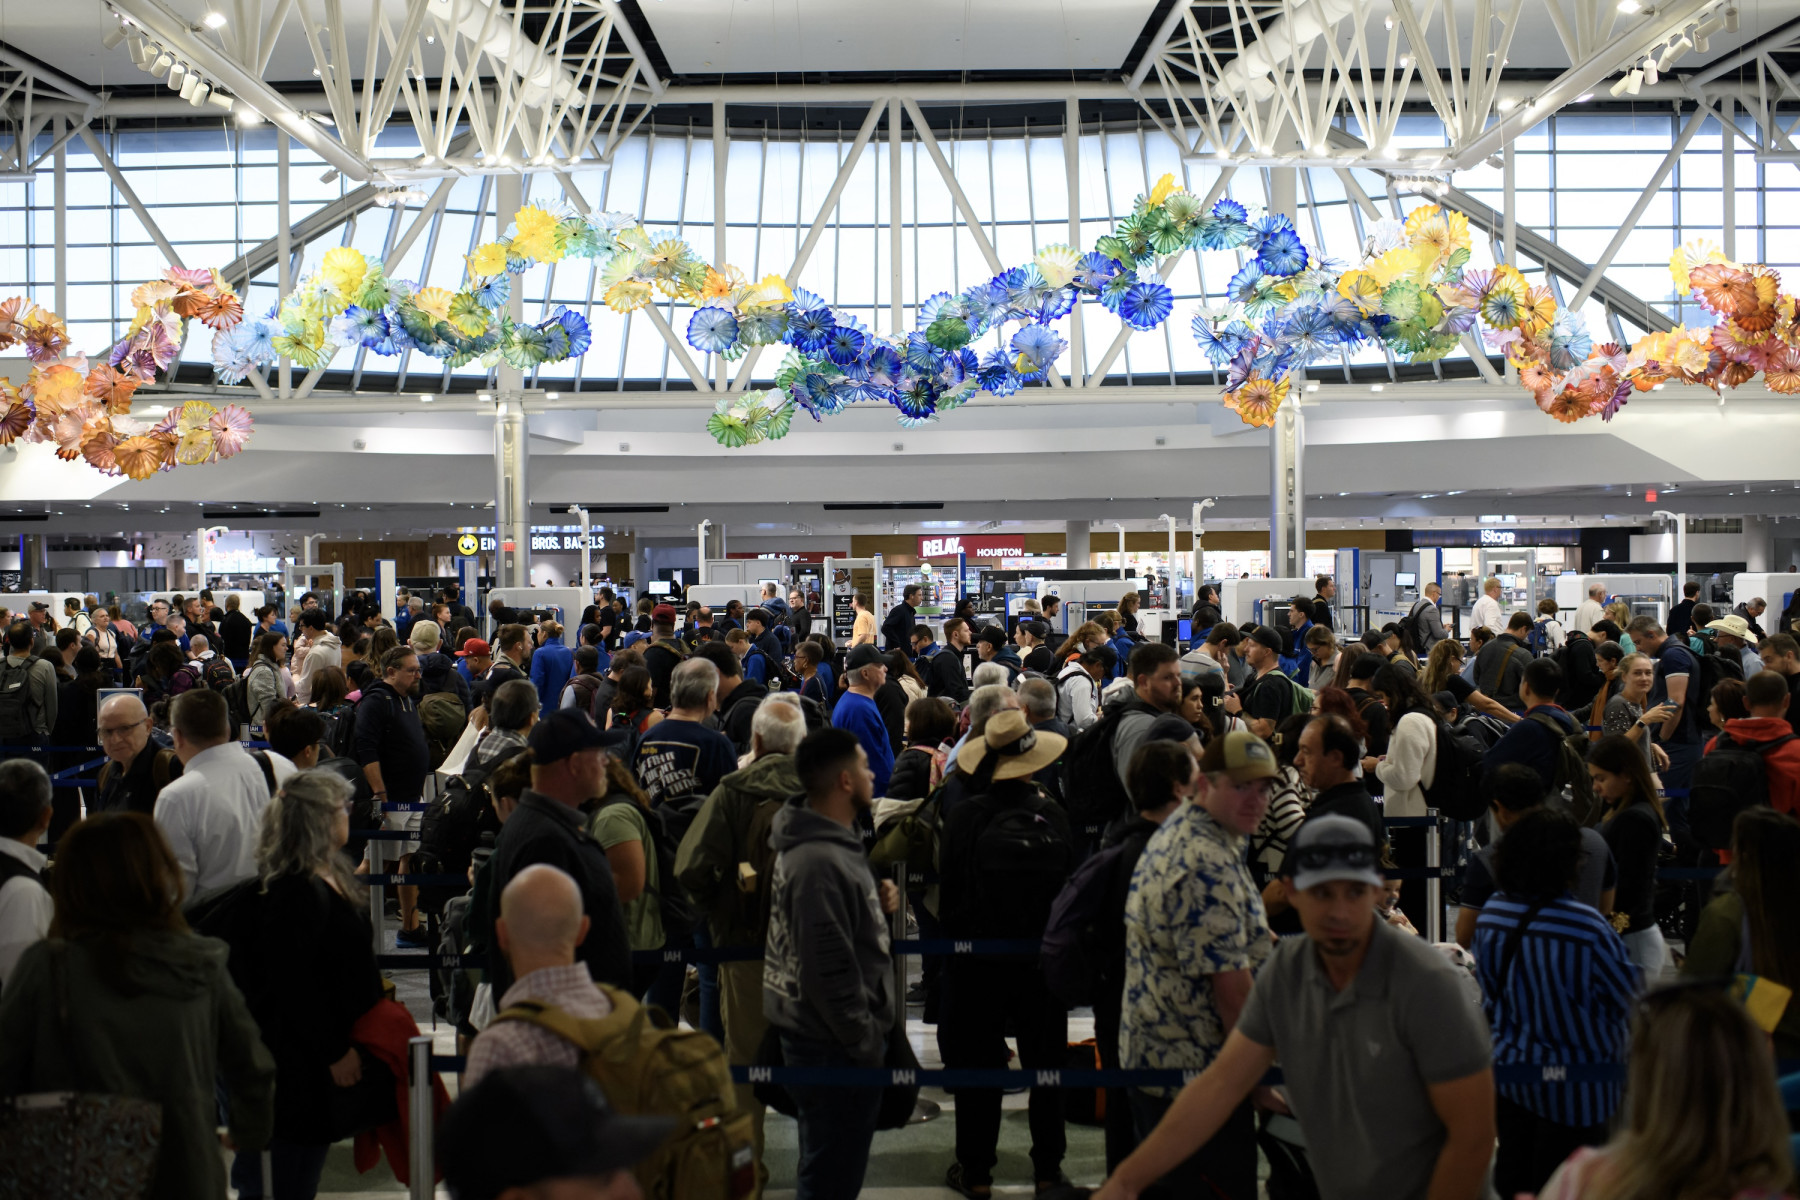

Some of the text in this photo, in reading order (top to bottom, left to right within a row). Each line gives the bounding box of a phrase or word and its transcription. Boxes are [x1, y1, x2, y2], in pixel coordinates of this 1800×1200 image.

[1481, 530, 1515, 543] iStore
[531, 537, 560, 550] BROS.
[976, 548, 1022, 557] HOUSTON
[397, 803, 410, 811] IAH
[908, 873, 925, 883] IAH
[1440, 867, 1456, 877] IAH
[391, 875, 405, 884] IAH
[954, 941, 973, 953] IAH
[442, 955, 460, 968] IAH
[663, 950, 681, 962] IAH
[748, 1066, 772, 1083] IAH
[892, 1069, 916, 1086] IAH
[1036, 1069, 1061, 1087] IAH
[1541, 1065, 1567, 1082] IAH
